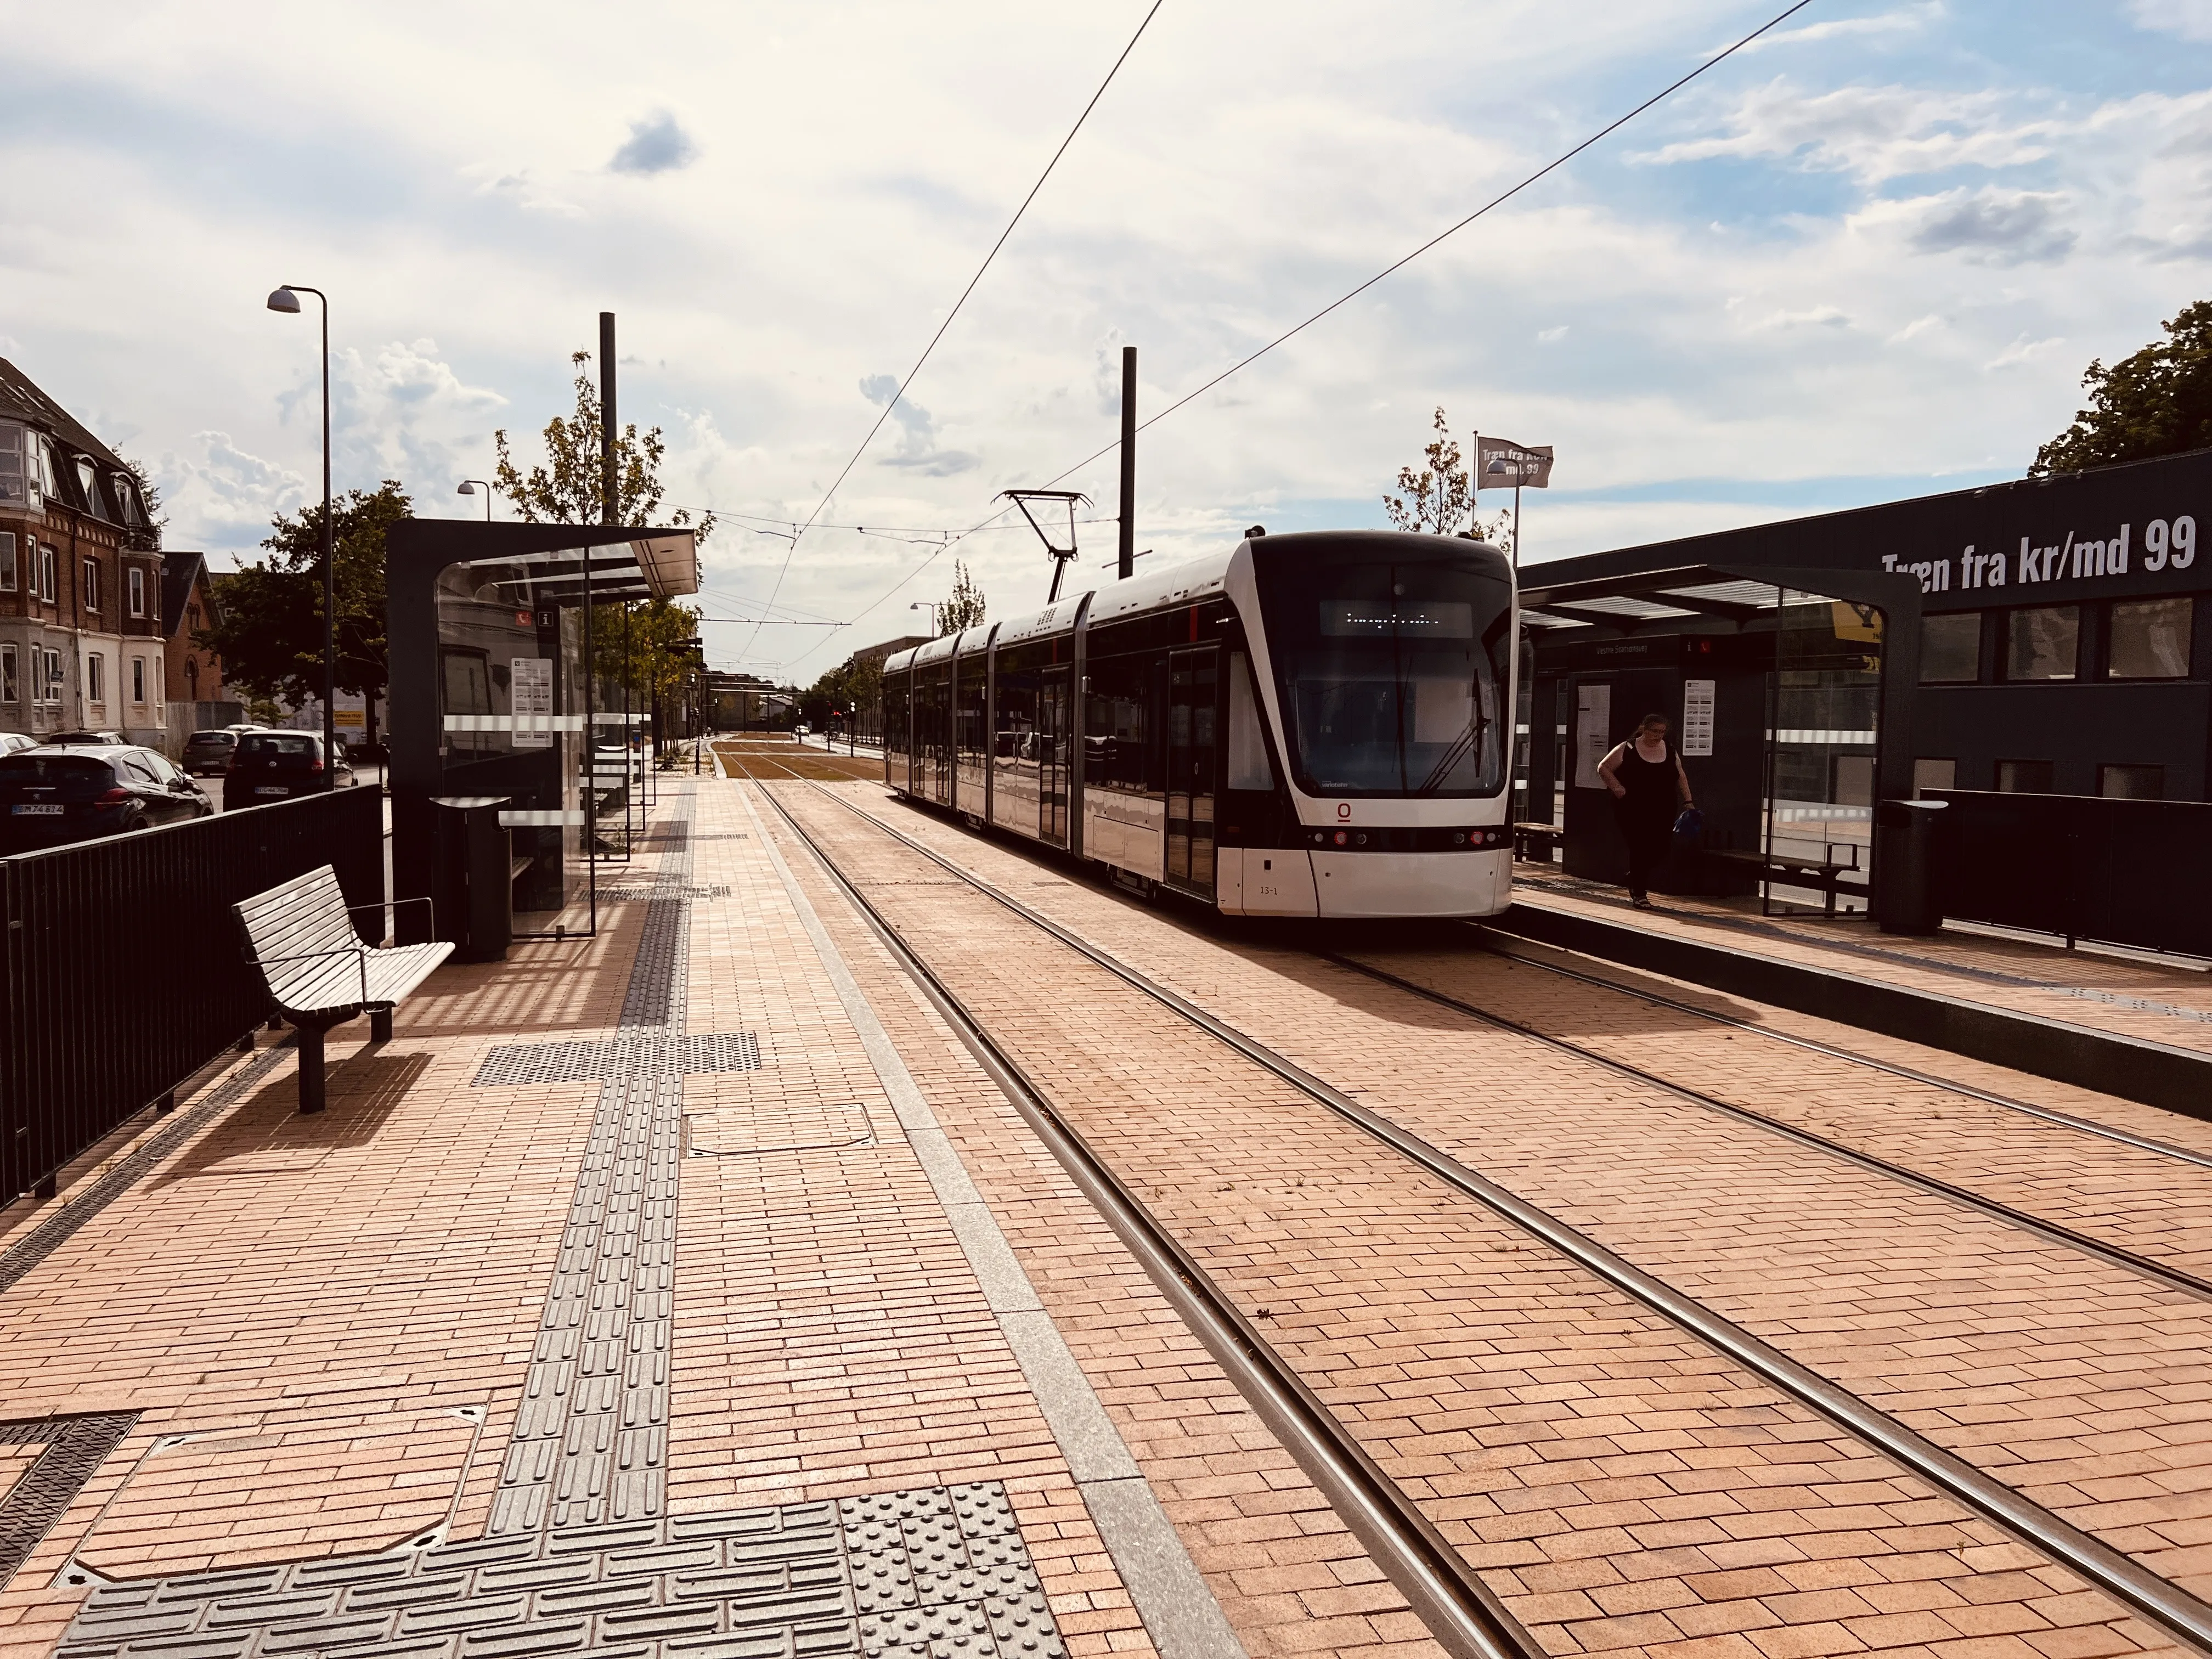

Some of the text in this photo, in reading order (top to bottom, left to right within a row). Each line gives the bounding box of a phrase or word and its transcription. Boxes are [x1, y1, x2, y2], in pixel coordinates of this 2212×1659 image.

[1483, 449, 1505, 461] Træn
[1508, 449, 1523, 461] fra
[1526, 463, 1539, 475] 99
[1882, 515, 2197, 593] Tæn fra kr/md 99
[1260, 886, 1278, 895] 13-1
